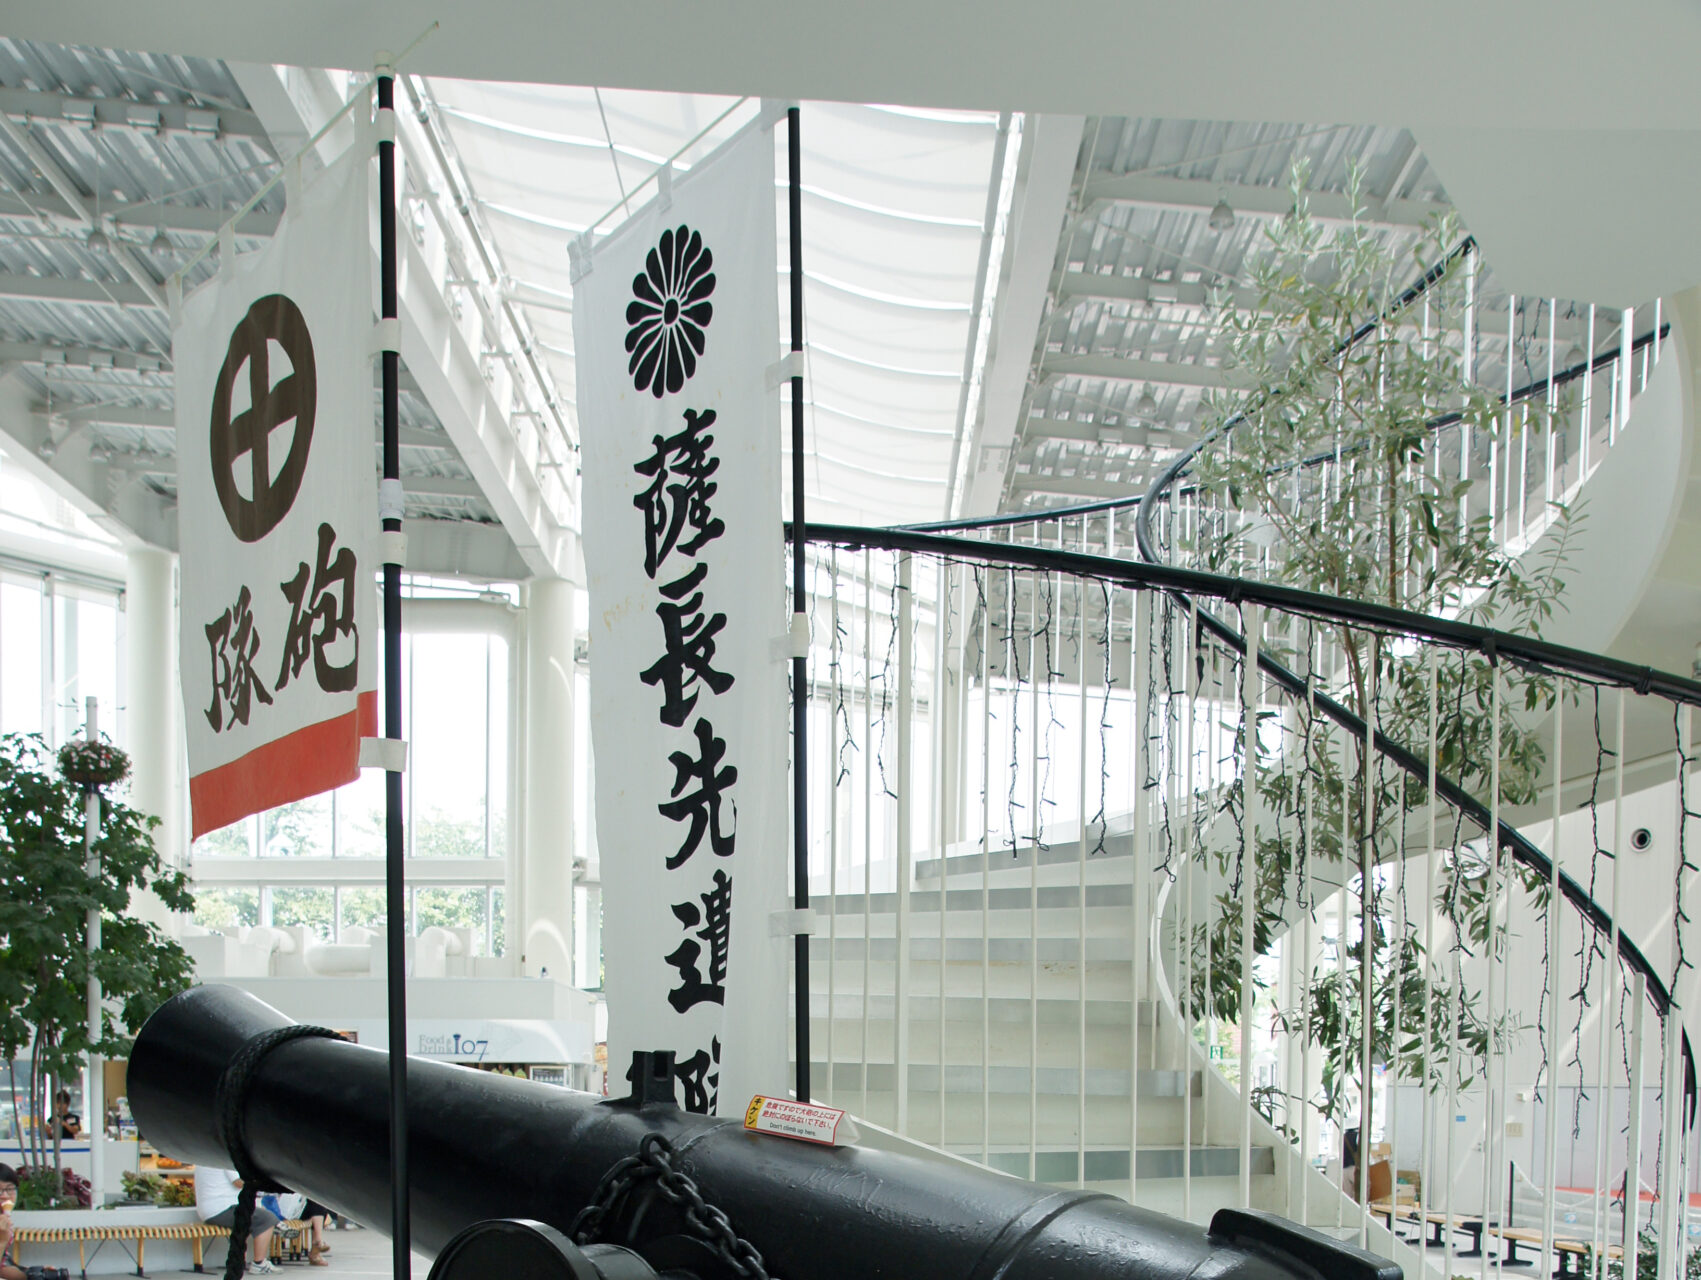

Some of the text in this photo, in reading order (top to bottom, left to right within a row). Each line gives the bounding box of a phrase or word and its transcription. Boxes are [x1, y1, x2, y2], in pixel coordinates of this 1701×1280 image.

[747, 1097, 762, 1125] キケン
[769, 1122, 783, 1130] Don't
[783, 1124, 797, 1132] climb
